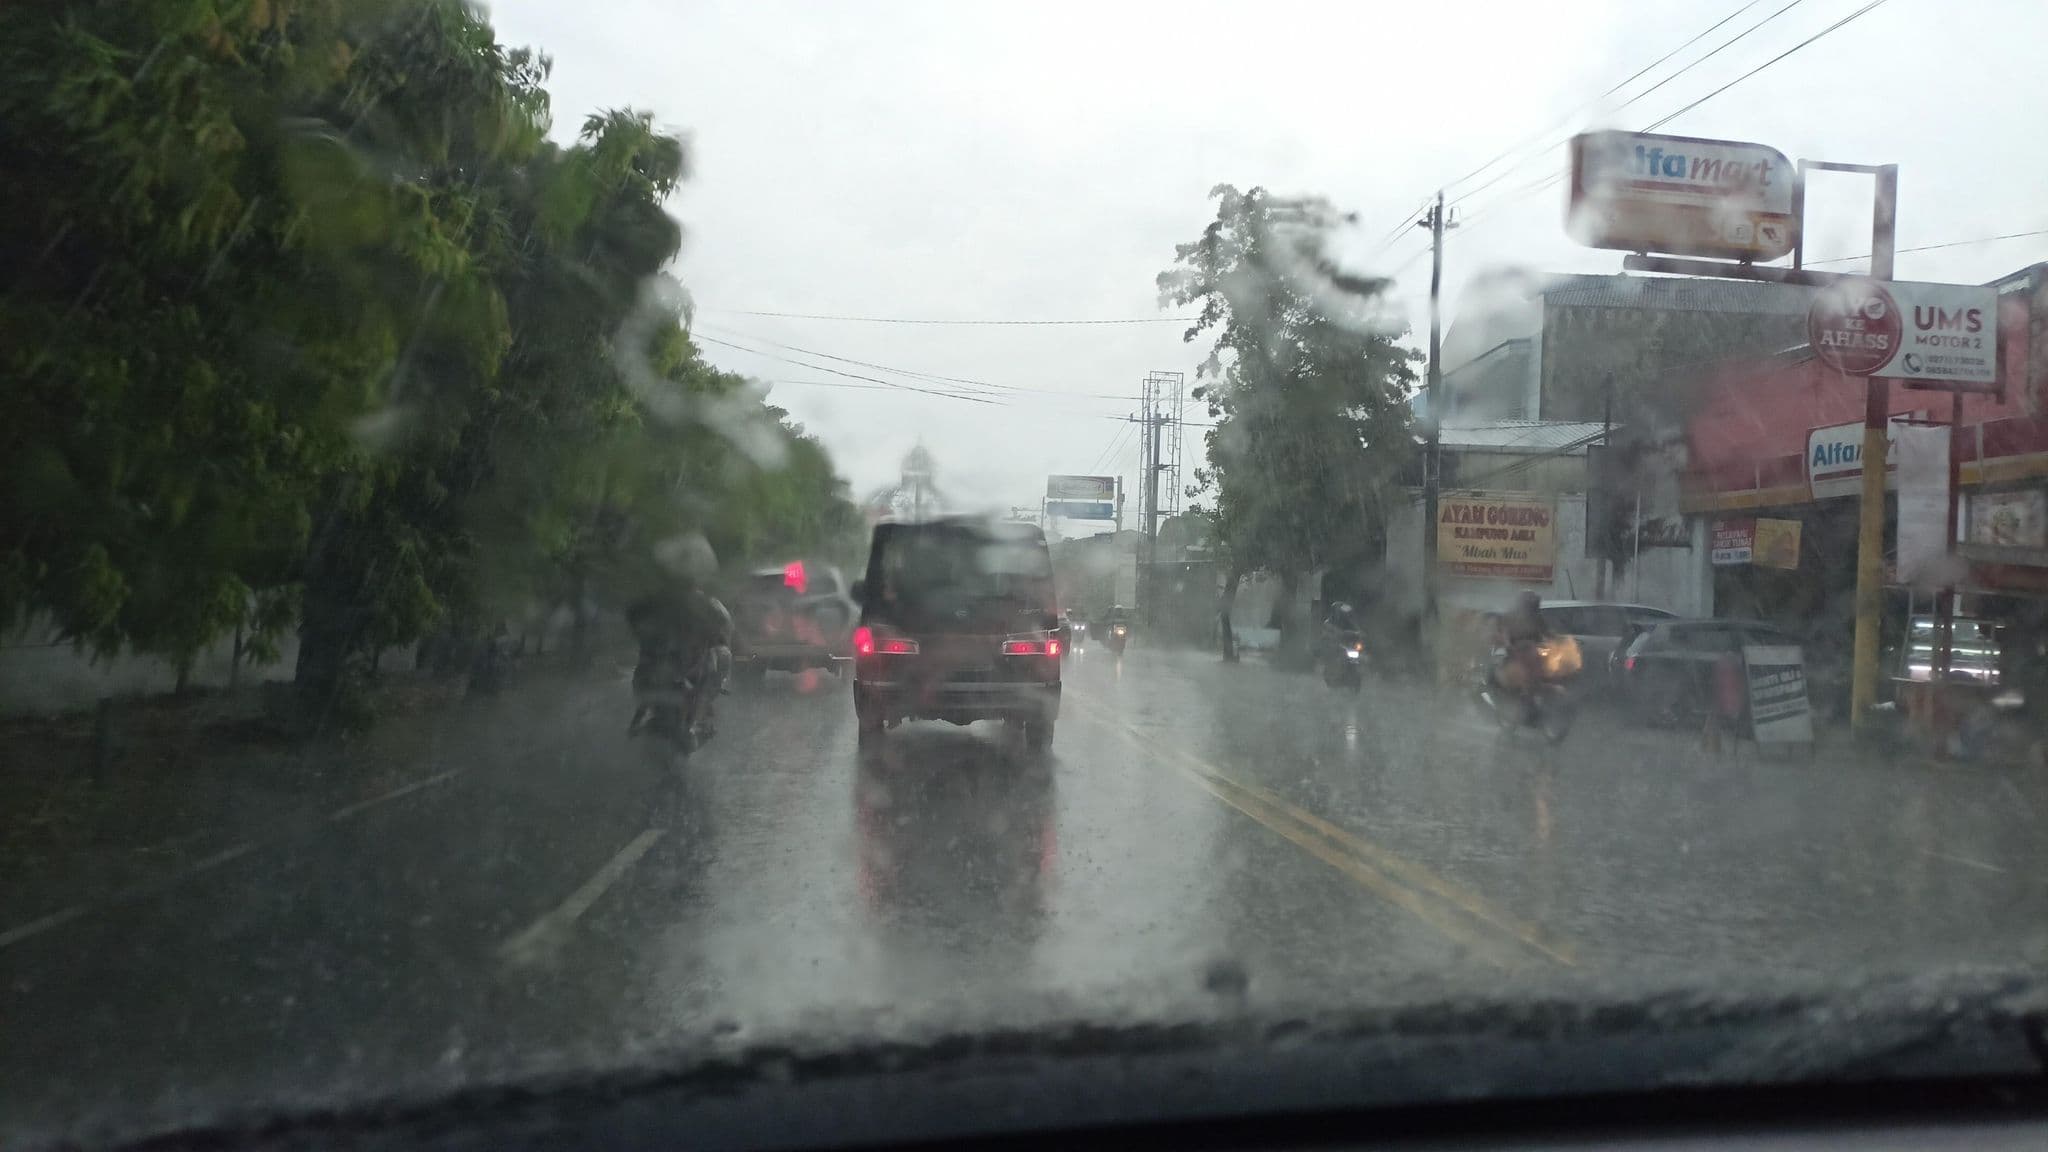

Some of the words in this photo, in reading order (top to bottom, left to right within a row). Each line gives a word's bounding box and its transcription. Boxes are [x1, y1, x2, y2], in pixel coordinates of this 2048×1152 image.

[1624, 144, 1774, 187] lfamart
[1914, 305, 1983, 333] UMS
[1819, 329, 1889, 350] AHASS
[1914, 334, 1970, 349] MOTOR
[1973, 337, 1984, 349] 2
[1441, 504, 1485, 525] AYAM
[1487, 505, 1550, 528] GORENG
